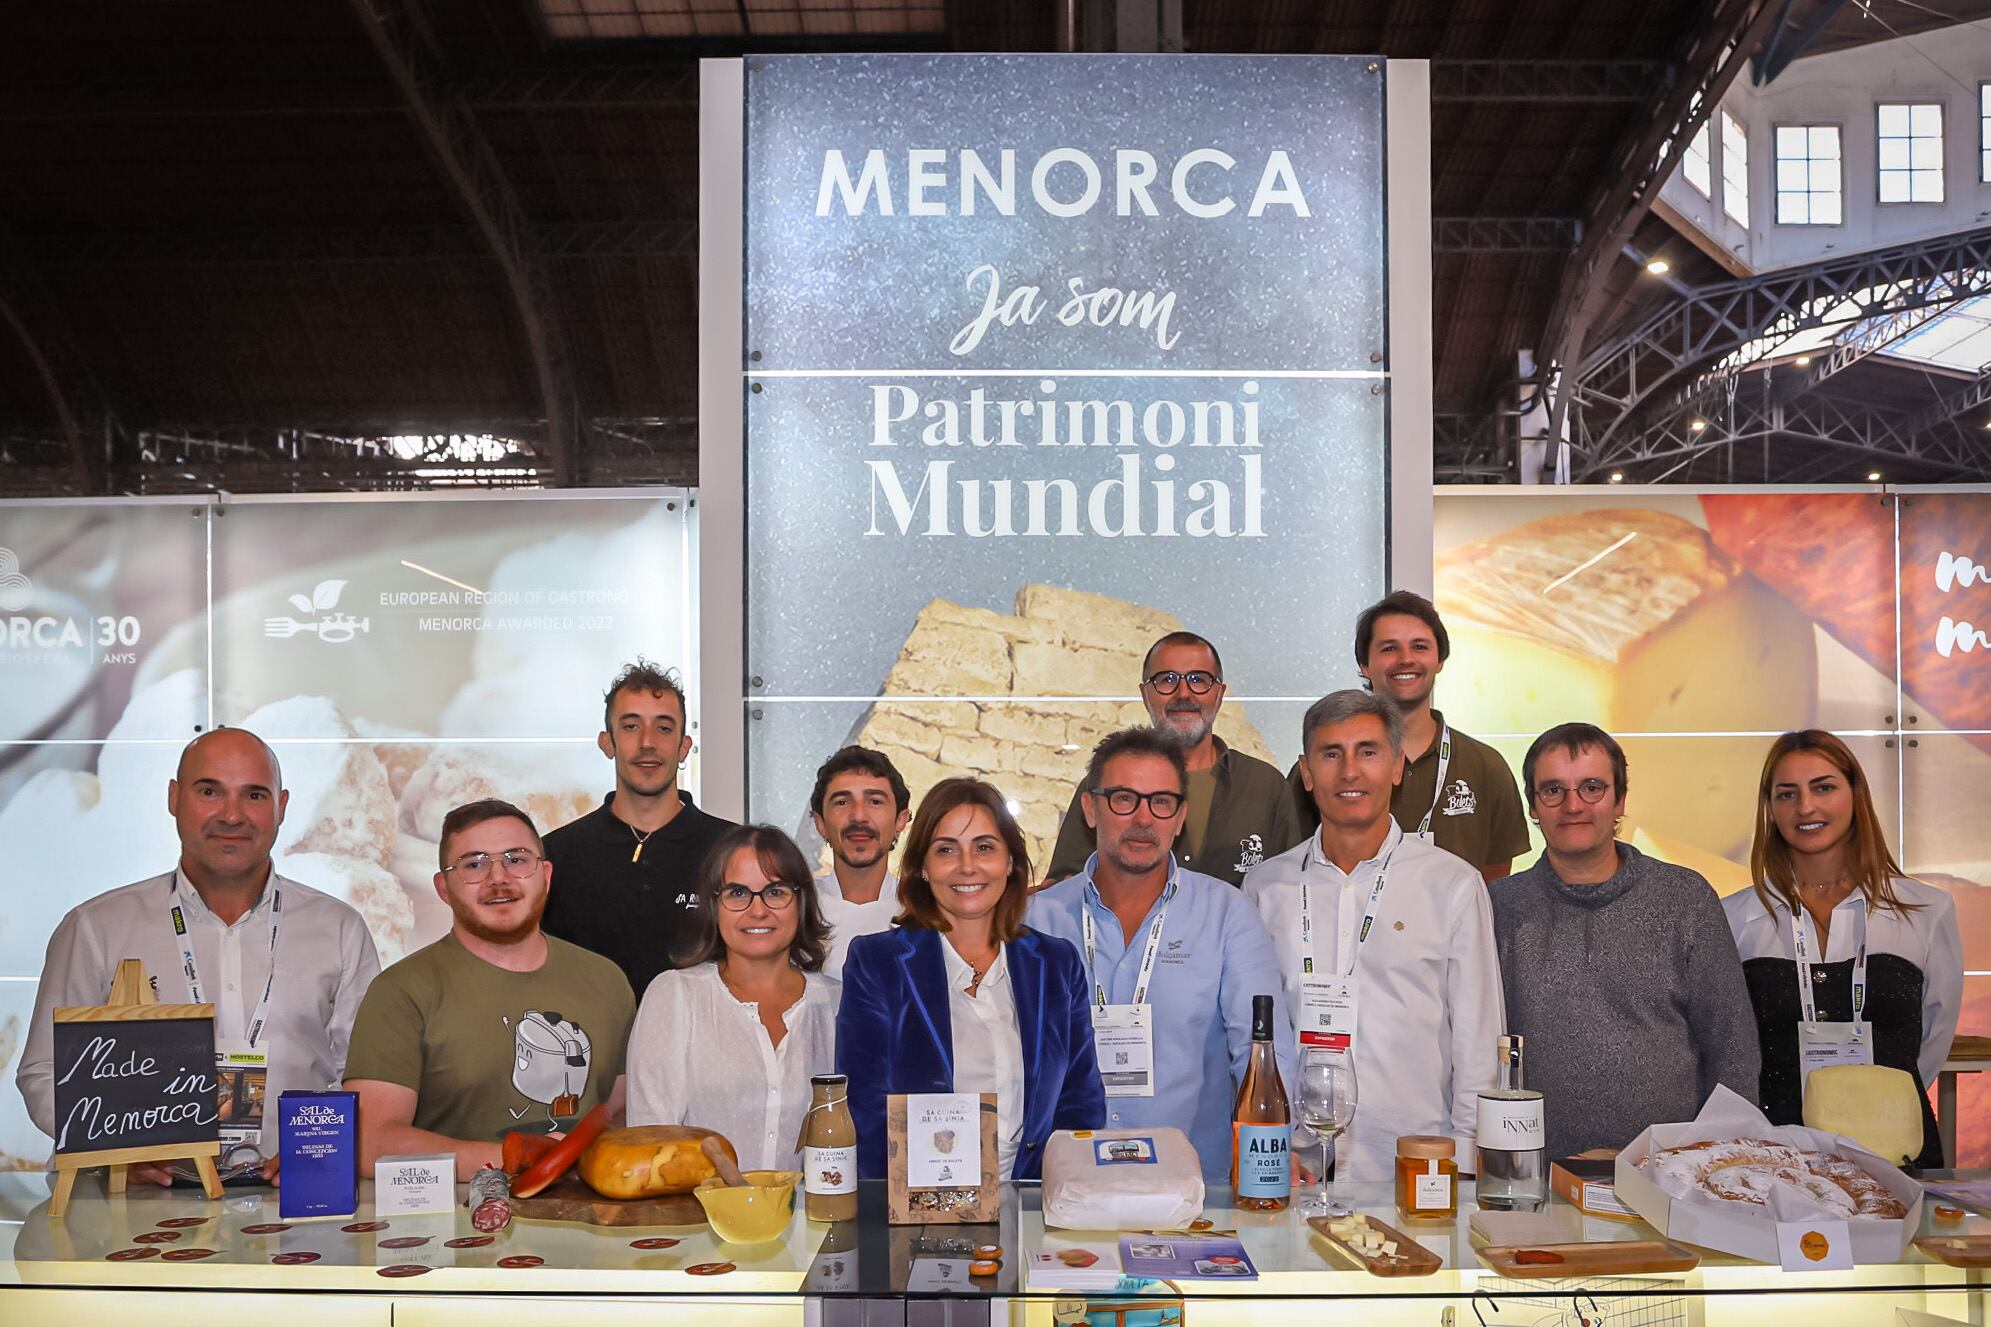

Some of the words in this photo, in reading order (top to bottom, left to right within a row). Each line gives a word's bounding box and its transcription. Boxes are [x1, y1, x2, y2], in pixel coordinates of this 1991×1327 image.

[816, 148, 1311, 217] MENORCA
[949, 264, 1047, 356] Ja
[1057, 276, 1182, 351] som
[868, 379, 1264, 448] Patrimoni
[863, 453, 1268, 538] Mundial
[380, 592, 460, 606] EUROPEAN
[465, 591, 519, 605] REGION
[524, 591, 544, 604] OF
[97, 616, 141, 647] 30
[419, 617, 490, 632] MENORCA
[497, 616, 573, 631] AWARDED
[578, 616, 614, 630] 2022
[102, 653, 137, 664] ANYS
[57, 1036, 160, 1086] Made
[163, 1067, 217, 1095] in
[300, 1106, 322, 1115] SAL
[323, 1106, 335, 1115] de
[56, 1096, 218, 1150] Menorca
[289, 1115, 345, 1126] MENORCA
[1249, 1137, 1288, 1154] ALBA
[1257, 1158, 1281, 1167] ROSÉ
[390, 1175, 439, 1186] MENORCA
[400, 1168, 420, 1177] SAL
[421, 1168, 431, 1177] de
